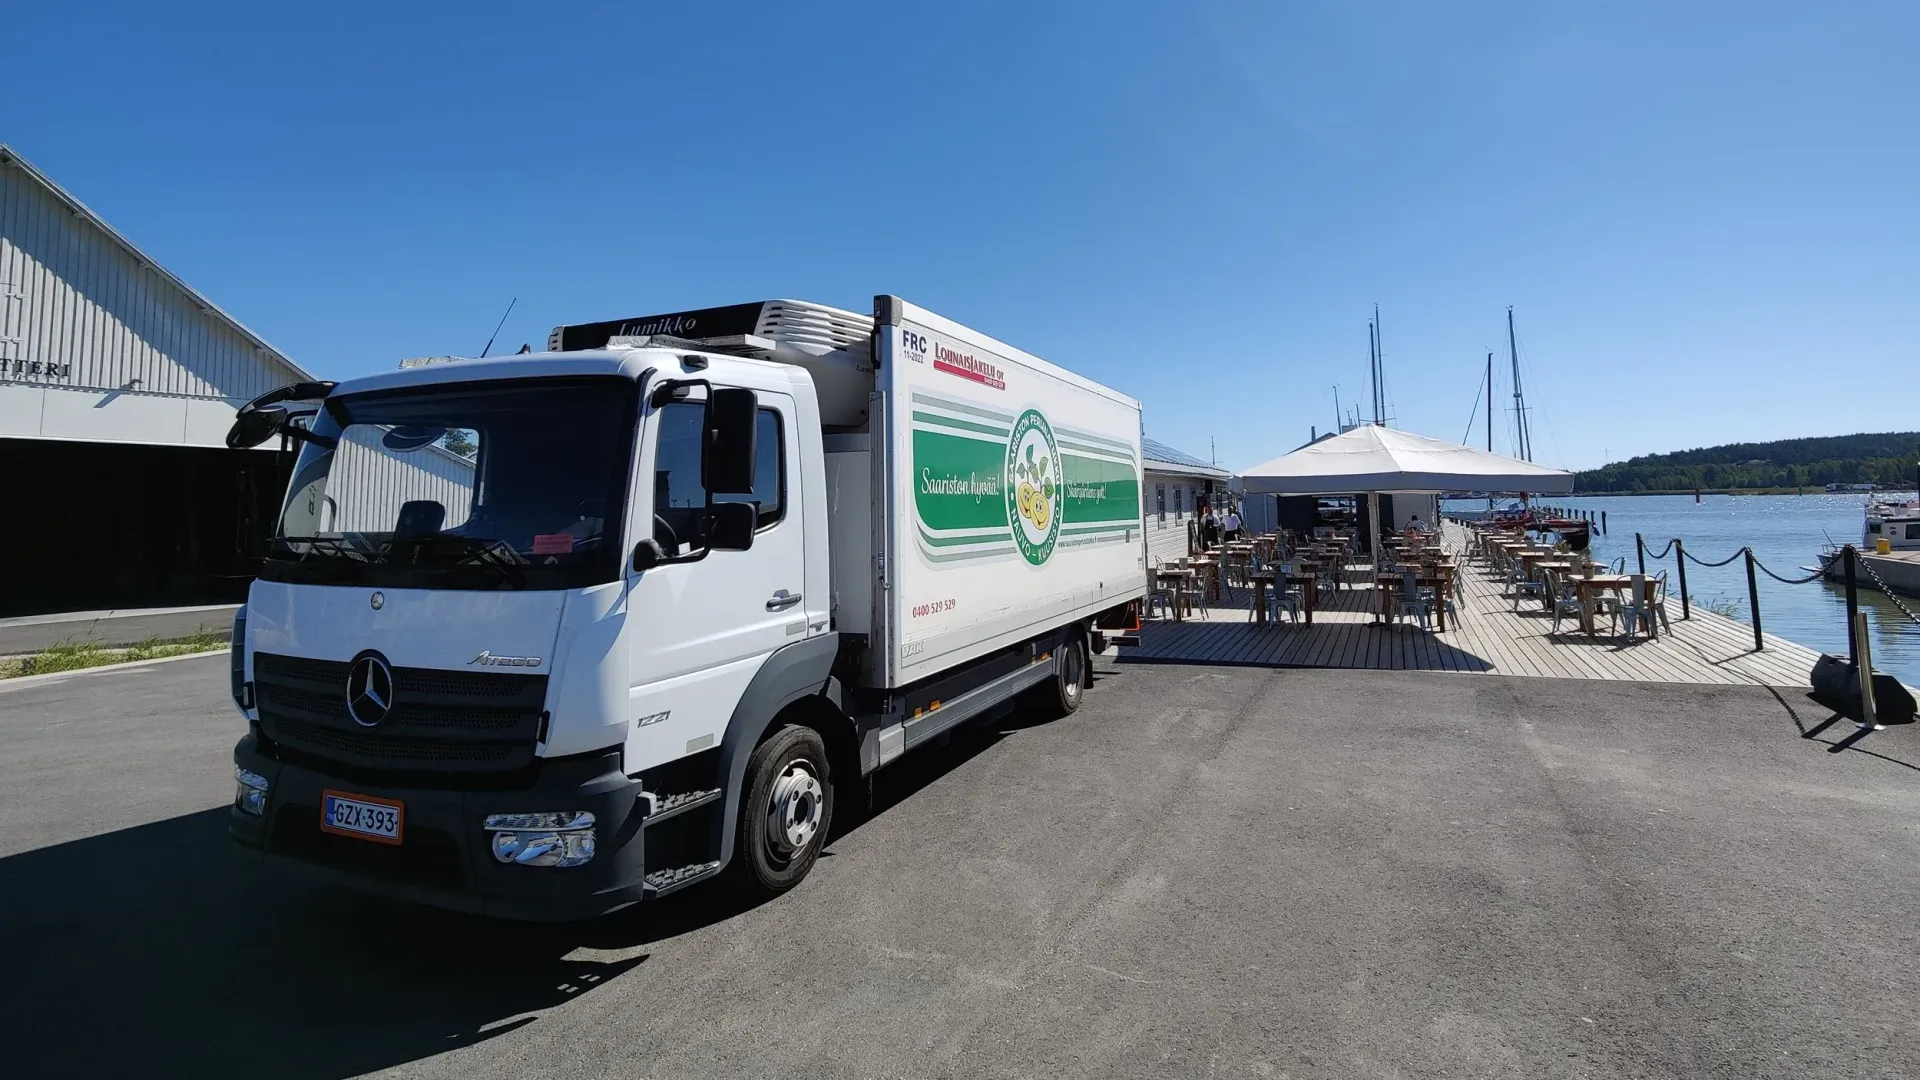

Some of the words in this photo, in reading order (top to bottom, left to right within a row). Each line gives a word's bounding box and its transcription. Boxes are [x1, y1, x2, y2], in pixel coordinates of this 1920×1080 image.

[619, 316, 697, 336] Lumikko
[902, 329, 927, 354] FRC
[903, 350, 924, 364] 11-2022
[921, 467, 970, 495] Saariston
[971, 471, 1000, 504] hyvää!
[1010, 507, 1031, 557] NAUVO
[1037, 506, 1060, 562] KUUSISTO
[912, 604, 930, 618] 0400
[931, 601, 943, 614] 529
[944, 598, 956, 611] 529
[637, 709, 671, 729] 1221
[335, 803, 395, 833] GZX-393
